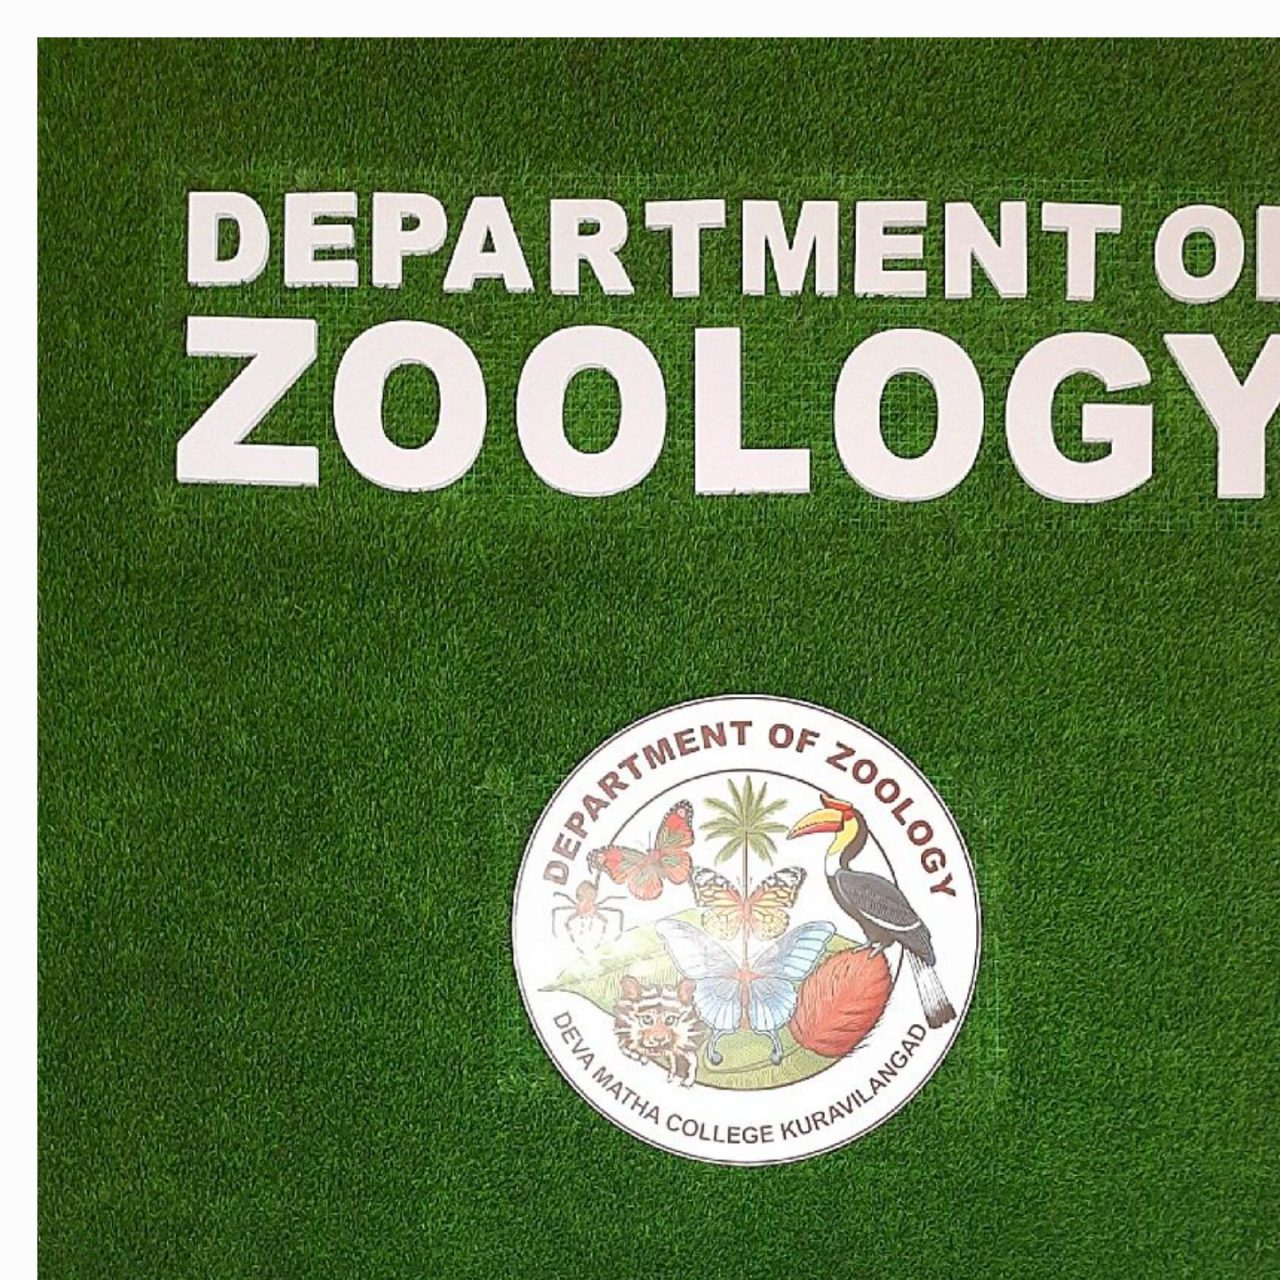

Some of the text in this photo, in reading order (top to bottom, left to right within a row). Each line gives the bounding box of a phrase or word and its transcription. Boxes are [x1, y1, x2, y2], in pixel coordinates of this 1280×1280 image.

[186, 190, 1122, 300] DEPARTMENT
[543, 719, 957, 899] DEPARTMENT OF ZOOLOGY
[552, 1011, 928, 1145] DEVA MATHA COLLEGE KURAVILANGAD
